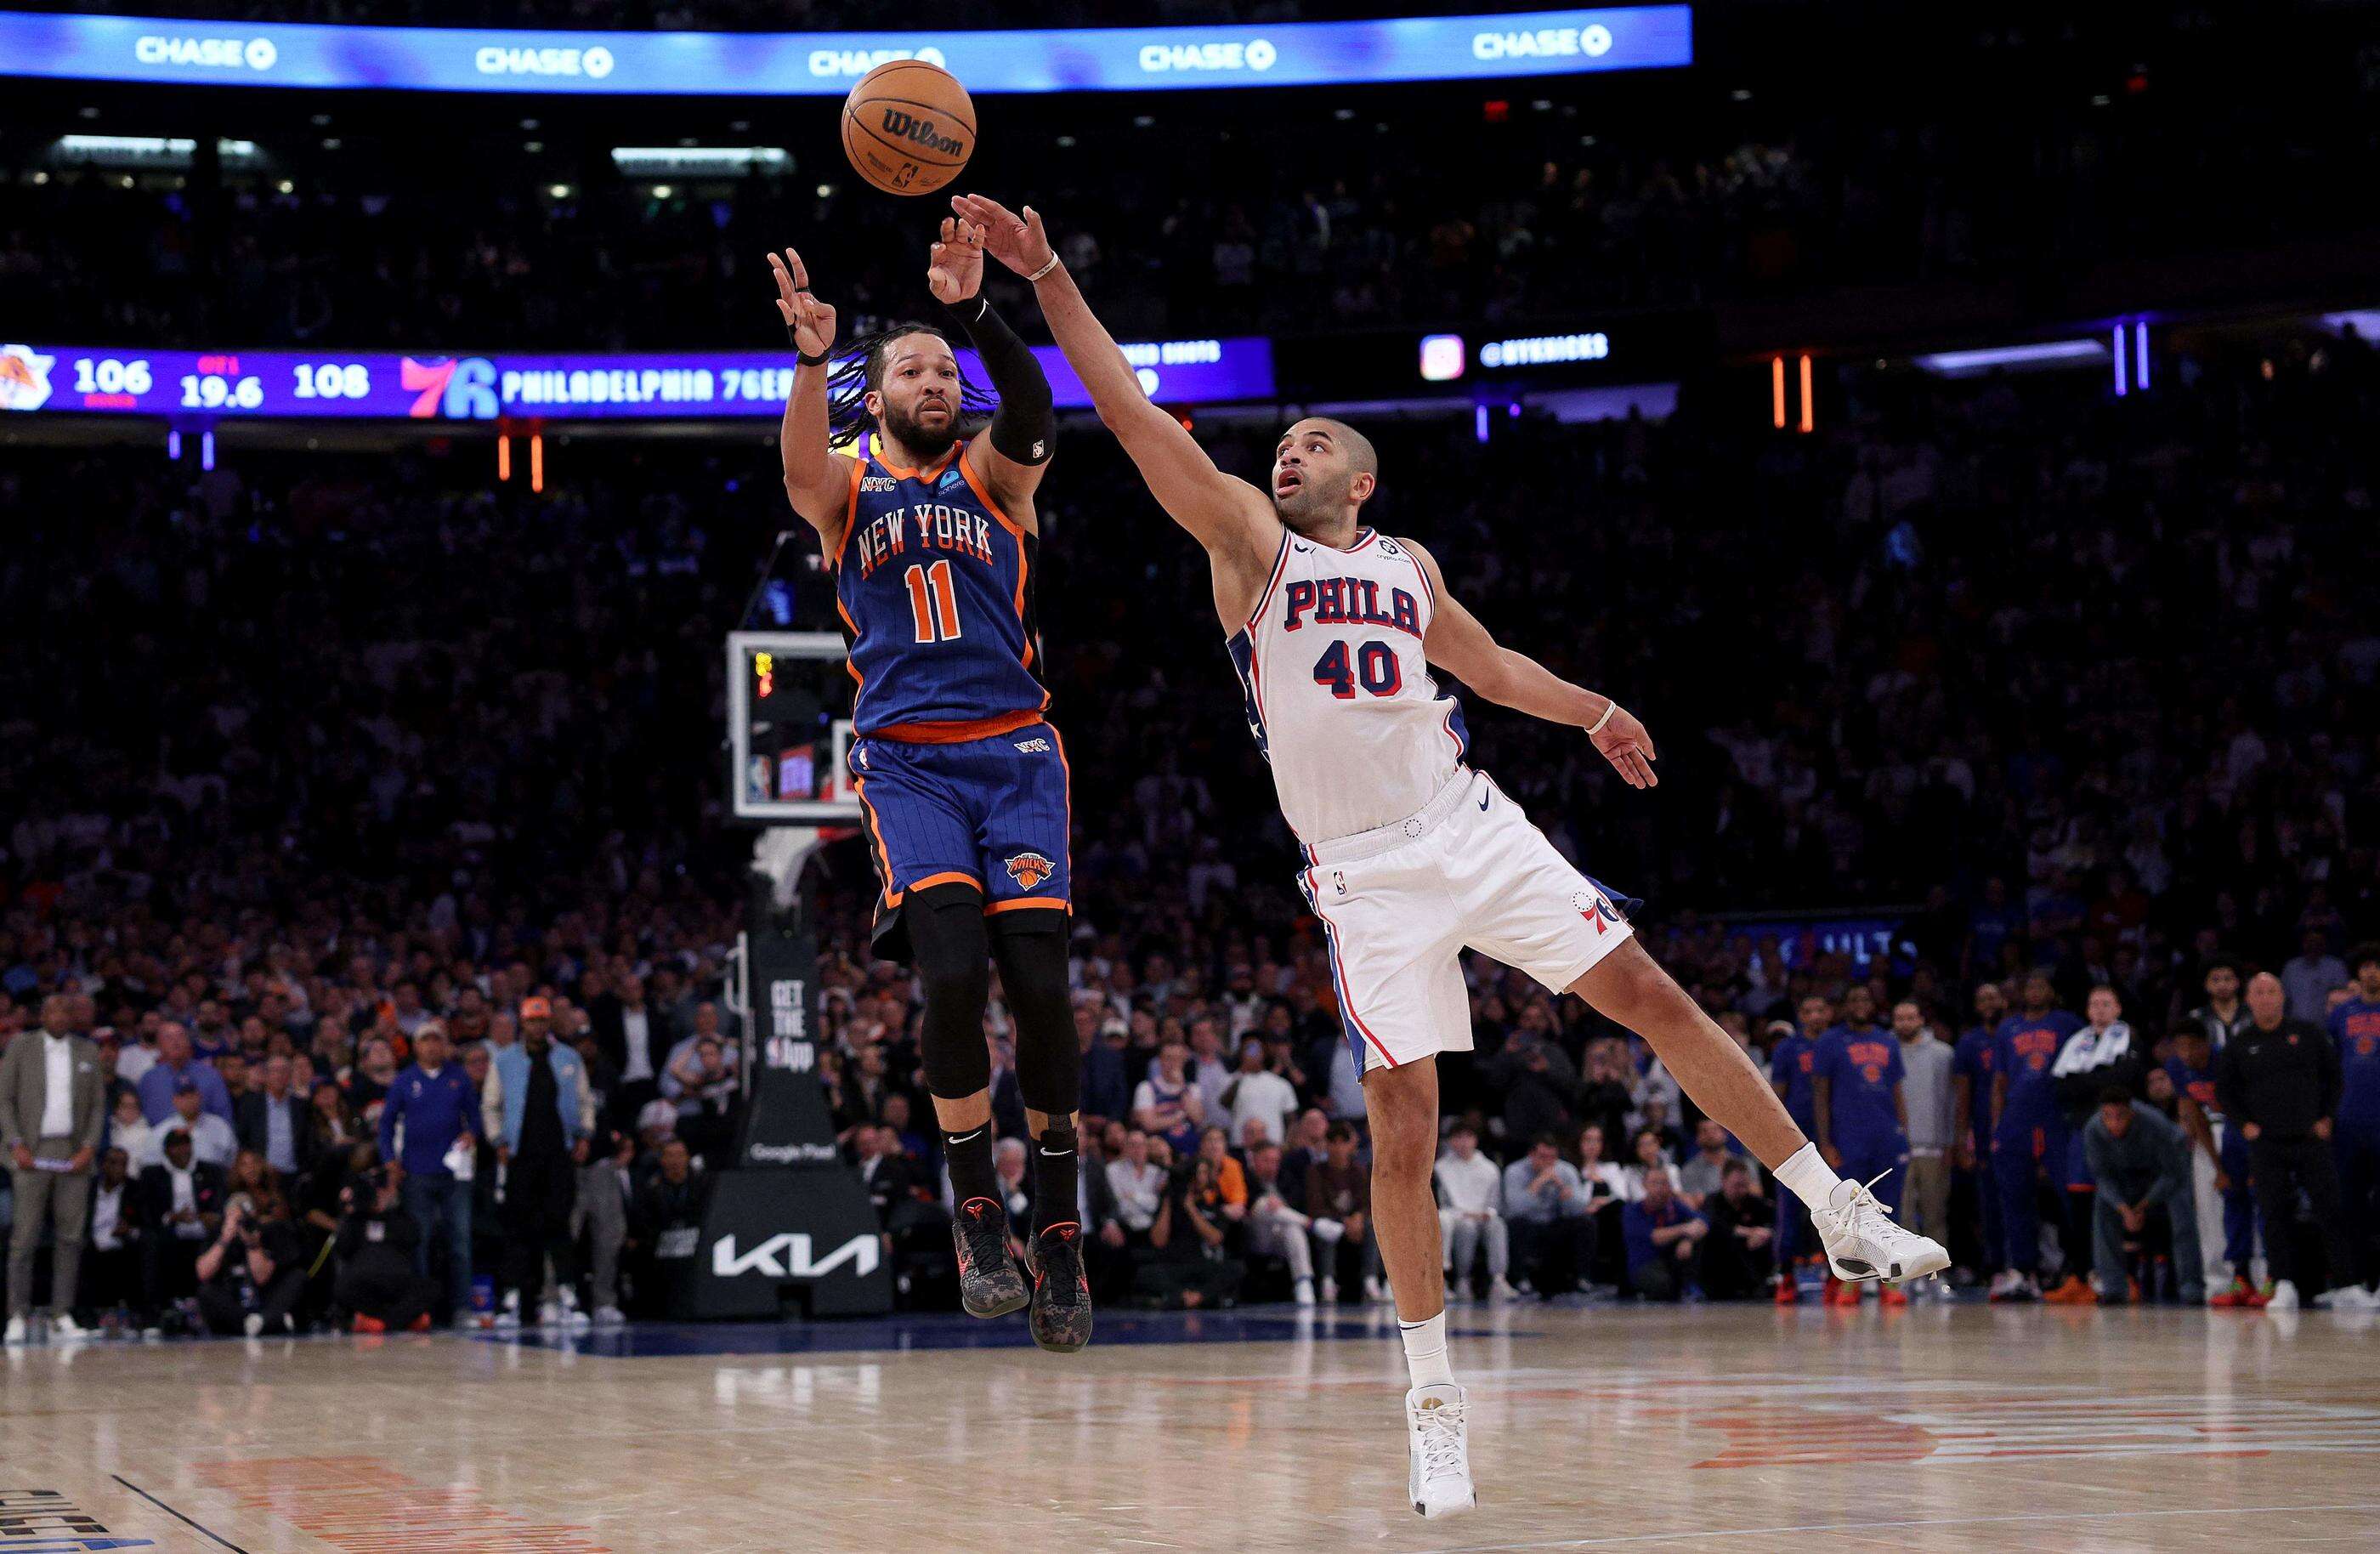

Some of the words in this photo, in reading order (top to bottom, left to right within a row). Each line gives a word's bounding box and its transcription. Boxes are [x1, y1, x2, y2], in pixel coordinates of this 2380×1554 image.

[136, 36, 244, 68] CHASE
[1139, 43, 1244, 72] CHASE
[1472, 28, 1579, 60] CHASE
[476, 47, 582, 76] CHASE
[882, 108, 963, 157] Wilson
[74, 357, 152, 394] 106
[180, 374, 264, 408] 19.6
[292, 363, 371, 399] 108
[401, 356, 500, 419] 76
[502, 369, 714, 403] PHILADELPHIA
[860, 476, 896, 492] NYC
[938, 479, 965, 496] sphere
[857, 508, 905, 581] NEW
[914, 503, 994, 566] YORK
[1376, 553, 1412, 564] crypto.com
[904, 559, 962, 644] 11
[1284, 576, 1423, 641] PHILA
[1313, 639, 1402, 699] 40
[1009, 857, 1051, 876] KNICKS
[770, 978, 804, 1007] GET
